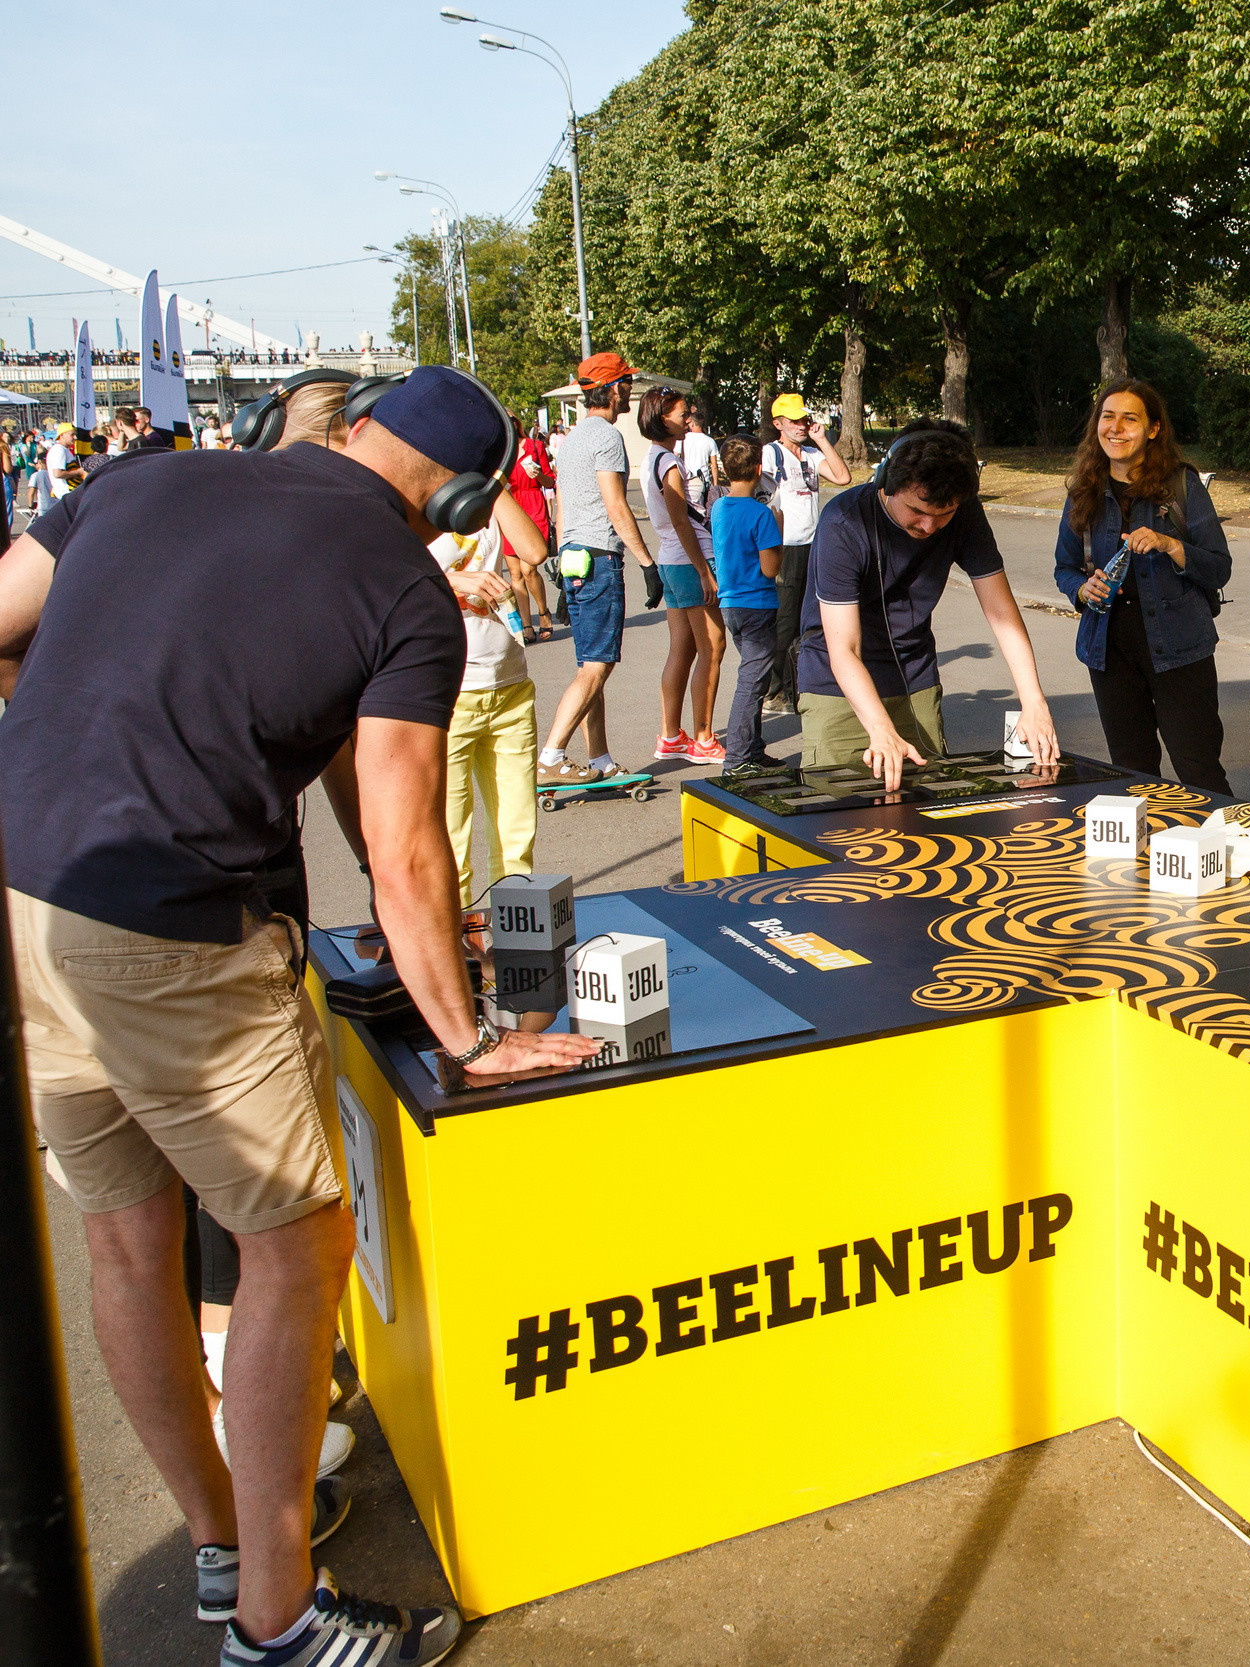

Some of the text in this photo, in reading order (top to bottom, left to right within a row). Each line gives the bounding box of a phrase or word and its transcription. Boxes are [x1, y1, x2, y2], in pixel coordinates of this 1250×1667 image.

[1092, 820, 1130, 843] JBL
[1156, 851, 1192, 880] JBL
[1201, 850, 1223, 879] JBL
[498, 905, 545, 933] JBL
[552, 896, 572, 929] JBL
[748, 917, 854, 968] Beelineup
[573, 968, 617, 1004] JBL
[628, 963, 664, 1002] JBL
[503, 1192, 1074, 1402] #BEELINEUP
